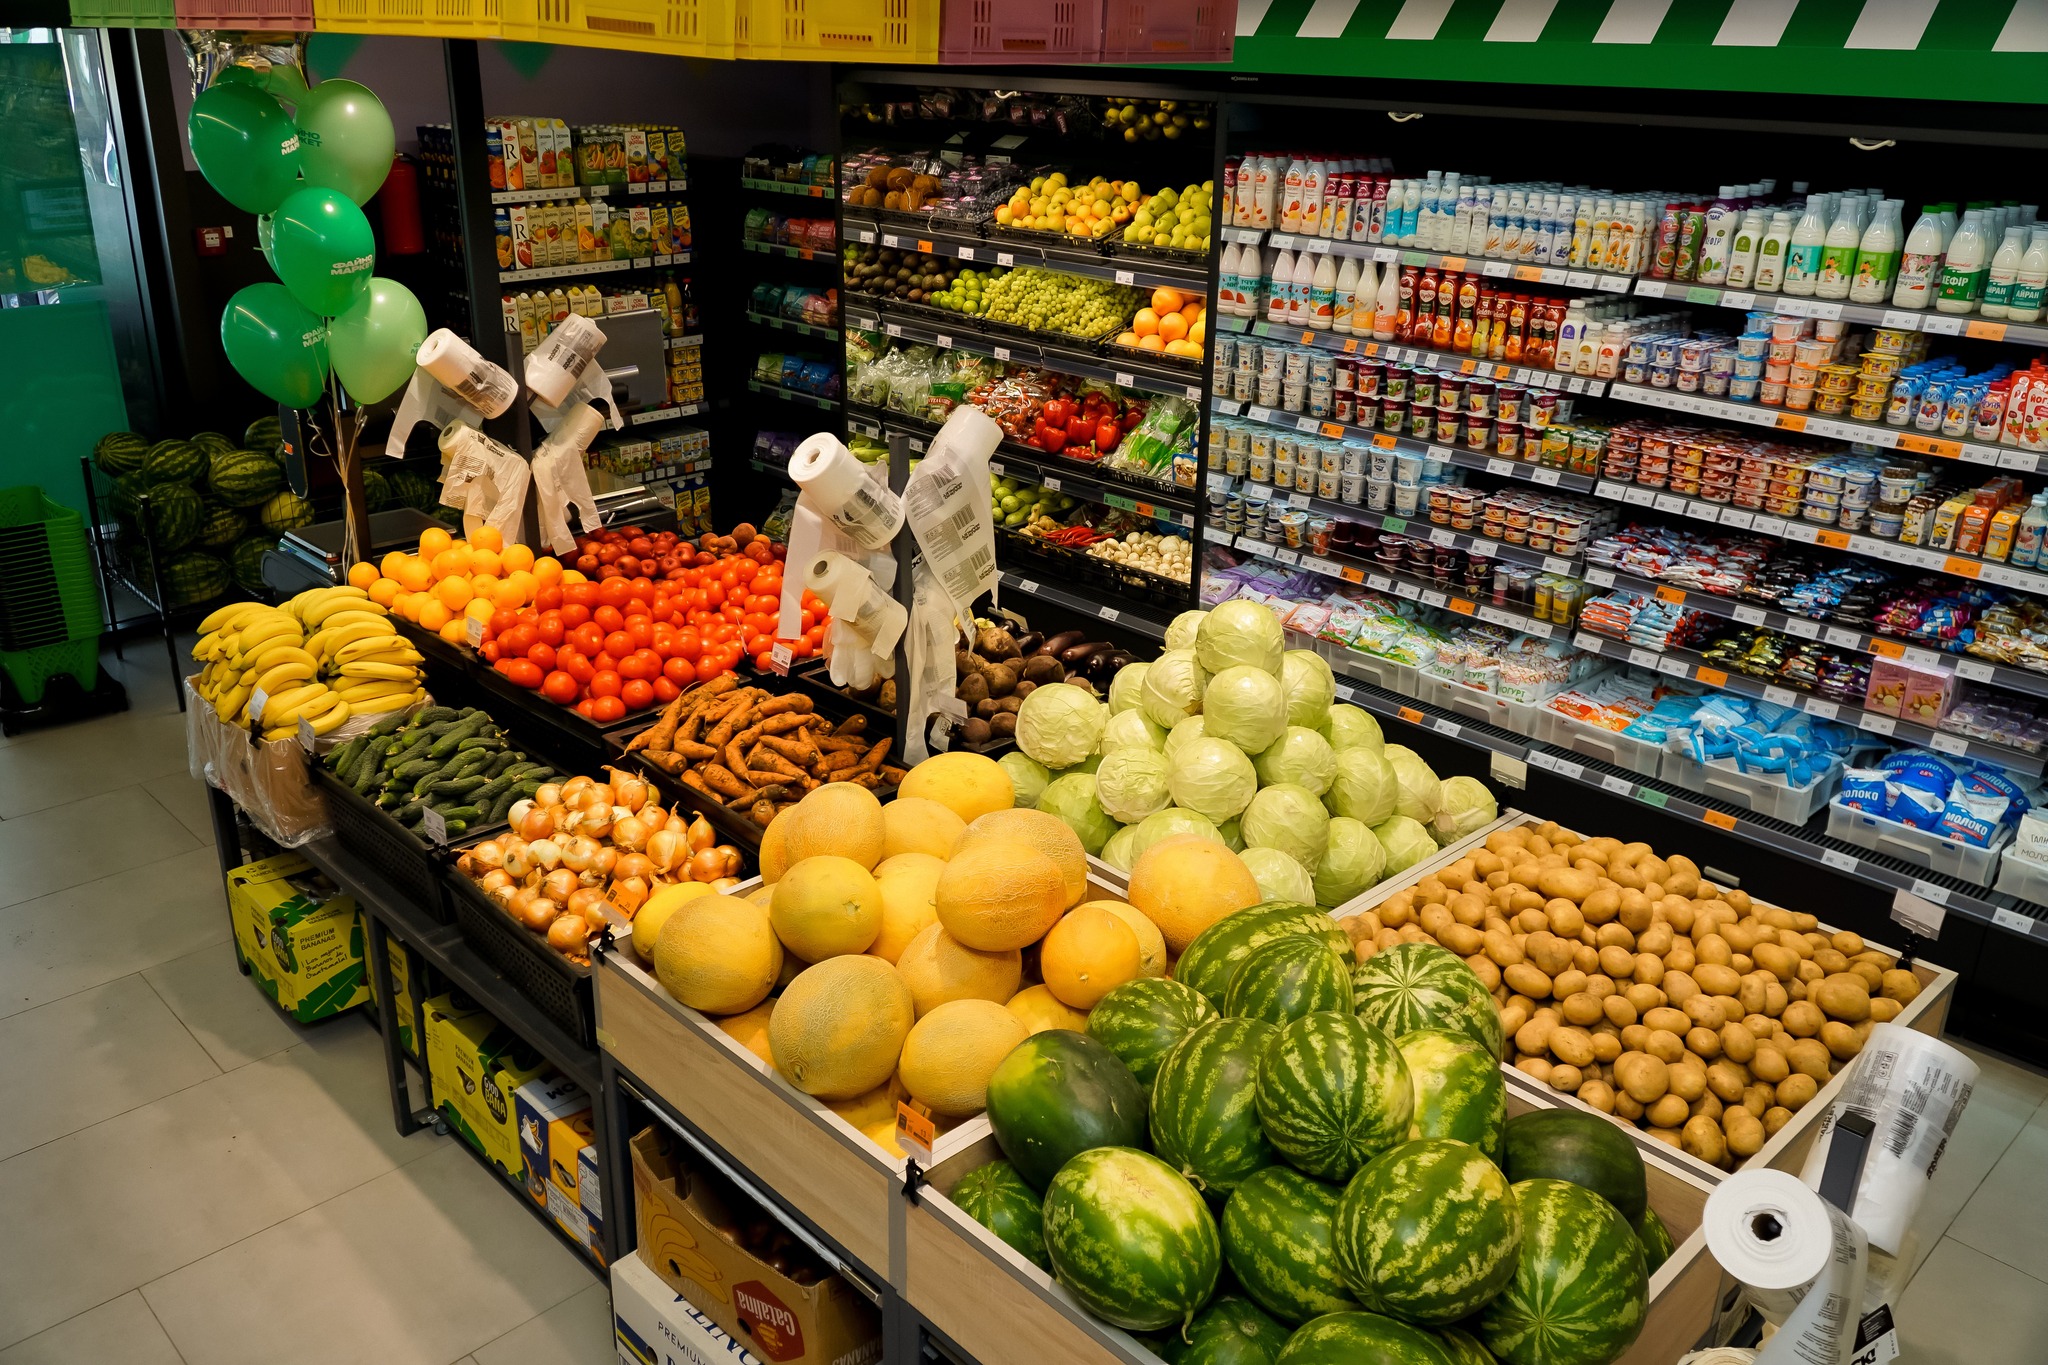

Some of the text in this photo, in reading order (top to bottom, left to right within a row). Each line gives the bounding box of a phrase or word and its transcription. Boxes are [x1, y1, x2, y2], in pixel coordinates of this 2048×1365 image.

[331, 260, 374, 276] МАРКЕТ
[332, 254, 373, 270] ФАЙНО
[2015, 289, 2040, 299] АЙРАН
[1944, 812, 1988, 836] МОЛОКО
[300, 927, 335, 944] PREMIUM
[301, 935, 336, 951] BANANAS
[455, 1044, 474, 1065] PREMIUM
[735, 1289, 796, 1337] Catalina
